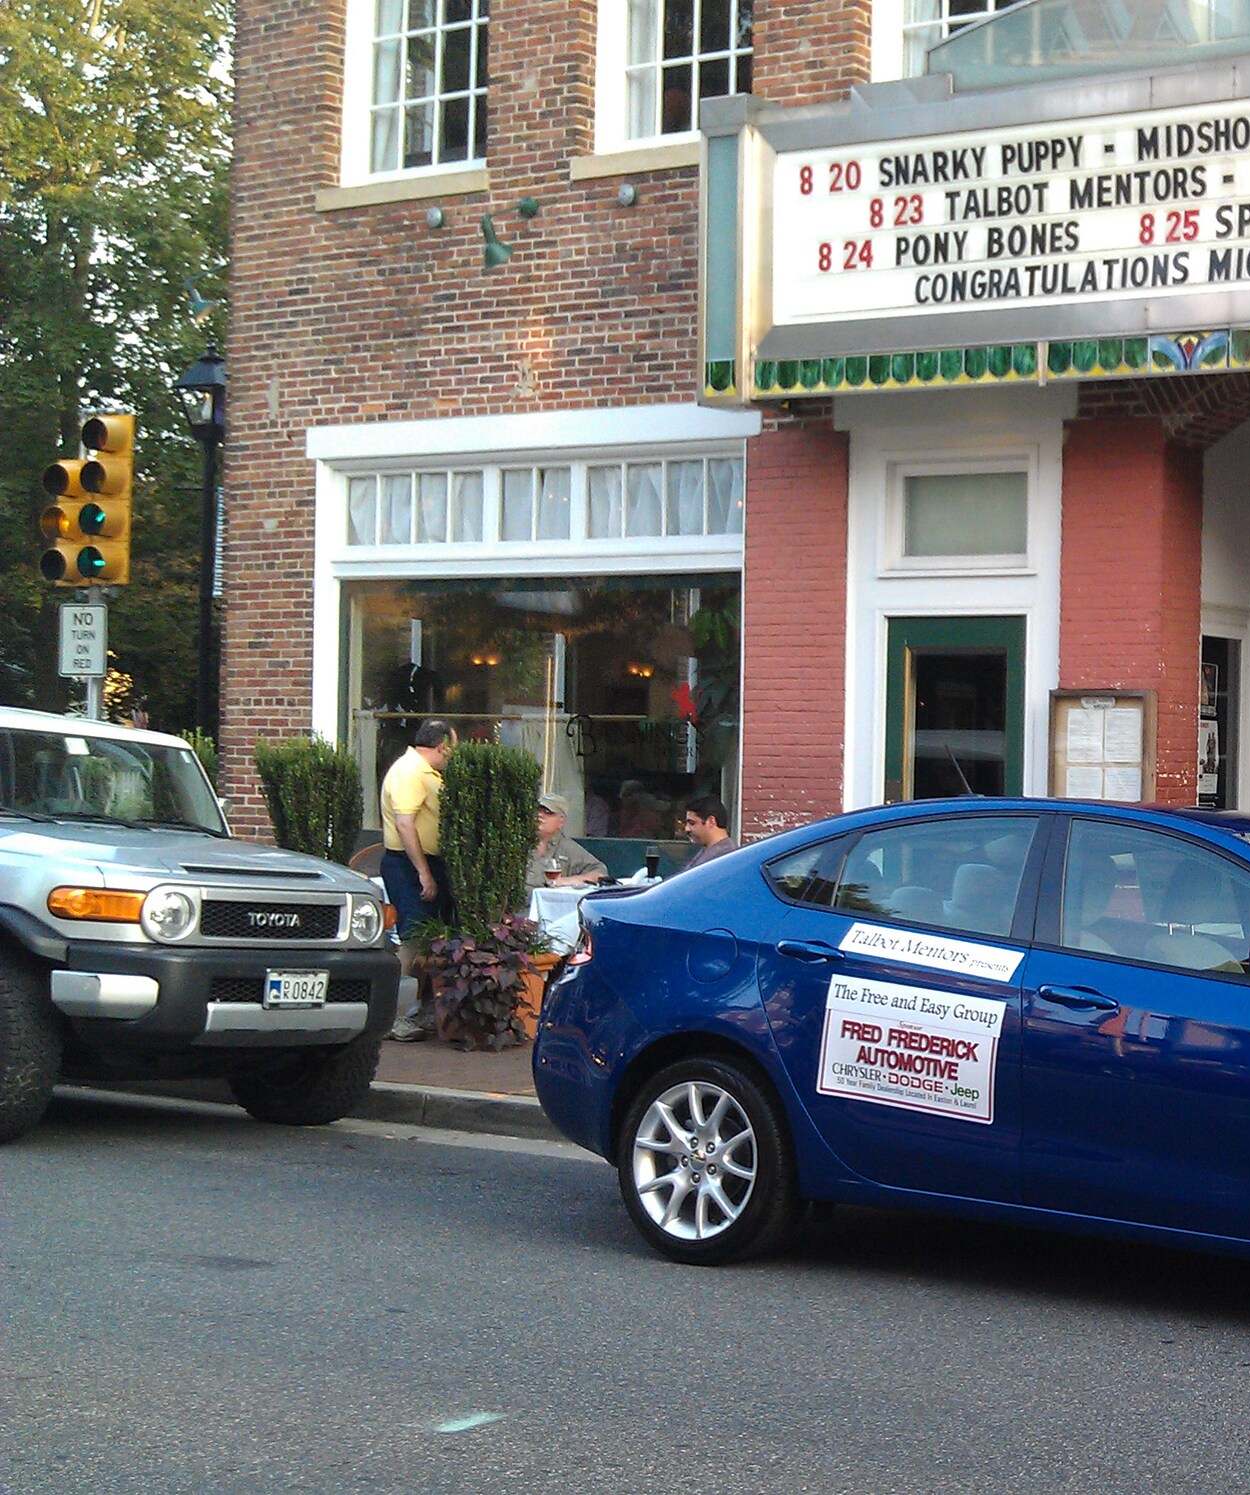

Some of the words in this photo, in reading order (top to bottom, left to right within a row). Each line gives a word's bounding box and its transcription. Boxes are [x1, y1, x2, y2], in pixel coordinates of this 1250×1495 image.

[800, 165, 813, 195] 8
[829, 161, 861, 193] 20
[879, 146, 986, 188] SNARKY
[1002, 136, 1084, 175] PUPPY
[870, 197, 884, 228] 8
[893, 194, 924, 226] 23
[945, 181, 1049, 222] TALBOT
[1069, 165, 1207, 210] MENTORS
[1139, 213, 1154, 245] 8
[1165, 209, 1200, 242] 25
[818, 242, 832, 272] 8
[843, 239, 874, 270] 24
[895, 230, 969, 267] PONY
[987, 221, 1079, 259] BONES
[914, 251, 1190, 304] CONGRATULATIONS
[72, 629, 96, 640] TURN
[73, 612, 93, 626] NO
[73, 658, 92, 669] RED
[76, 644, 90, 655] ON
[247, 912, 301, 927] TOYOTA
[852, 930, 899, 950] Talbot
[901, 940, 969, 963] Mentors
[292, 981, 324, 999] 0842
[834, 983, 858, 1001] The
[860, 988, 888, 1007] Free
[891, 995, 916, 1013] and
[920, 998, 950, 1020] Easy
[953, 1004, 998, 1028] Group
[840, 1019, 883, 1044] FRED
[887, 1028, 980, 1062] FREDERICK
[832, 1062, 881, 1081] CHRYSLER
[888, 1072, 943, 1093] DODGE
[950, 1082, 979, 1100] Jeep
[856, 1045, 959, 1081] AUTOMOTIVE
